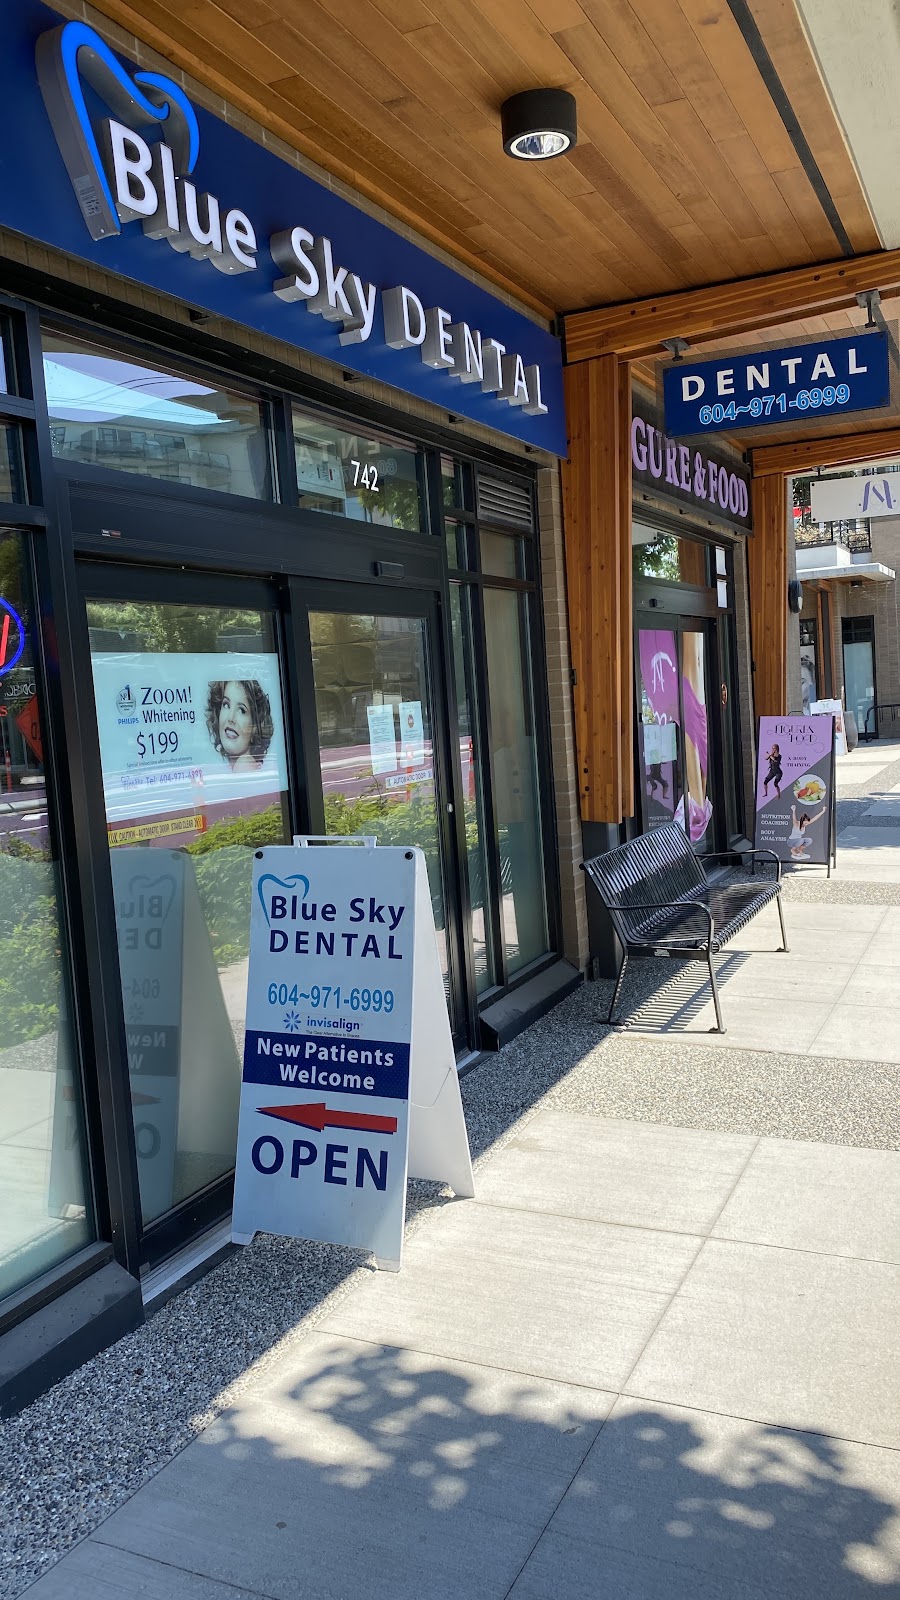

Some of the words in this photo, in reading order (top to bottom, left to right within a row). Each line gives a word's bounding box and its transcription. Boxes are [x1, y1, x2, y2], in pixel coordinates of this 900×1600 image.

[108, 117, 258, 271] Blue
[285, 226, 378, 344] Sky
[396, 285, 549, 416] DENTAL
[681, 348, 868, 402] DENTAL
[350, 460, 380, 492] 742
[117, 717, 140, 725] PHILIPS
[142, 707, 196, 725] Whitening
[136, 730, 179, 759] $199
[393, 774, 416, 785] AUTOMATIC
[416, 772, 426, 780] DOOR
[119, 830, 136, 842] CAUTION
[138, 826, 160, 838] AUTOMATIC
[159, 824, 170, 834] DOOR
[170, 821, 182, 832] STAND
[182, 819, 194, 830] CLEAR
[269, 894, 337, 922] Blue
[349, 896, 406, 931] Sky
[268, 928, 404, 960] DENTAL
[307, 1015, 360, 1033] invisalign
[256, 1037, 301, 1059] New
[304, 1040, 394, 1067] Patients
[279, 1063, 376, 1090] Welcome
[251, 1134, 389, 1192] OPEN
